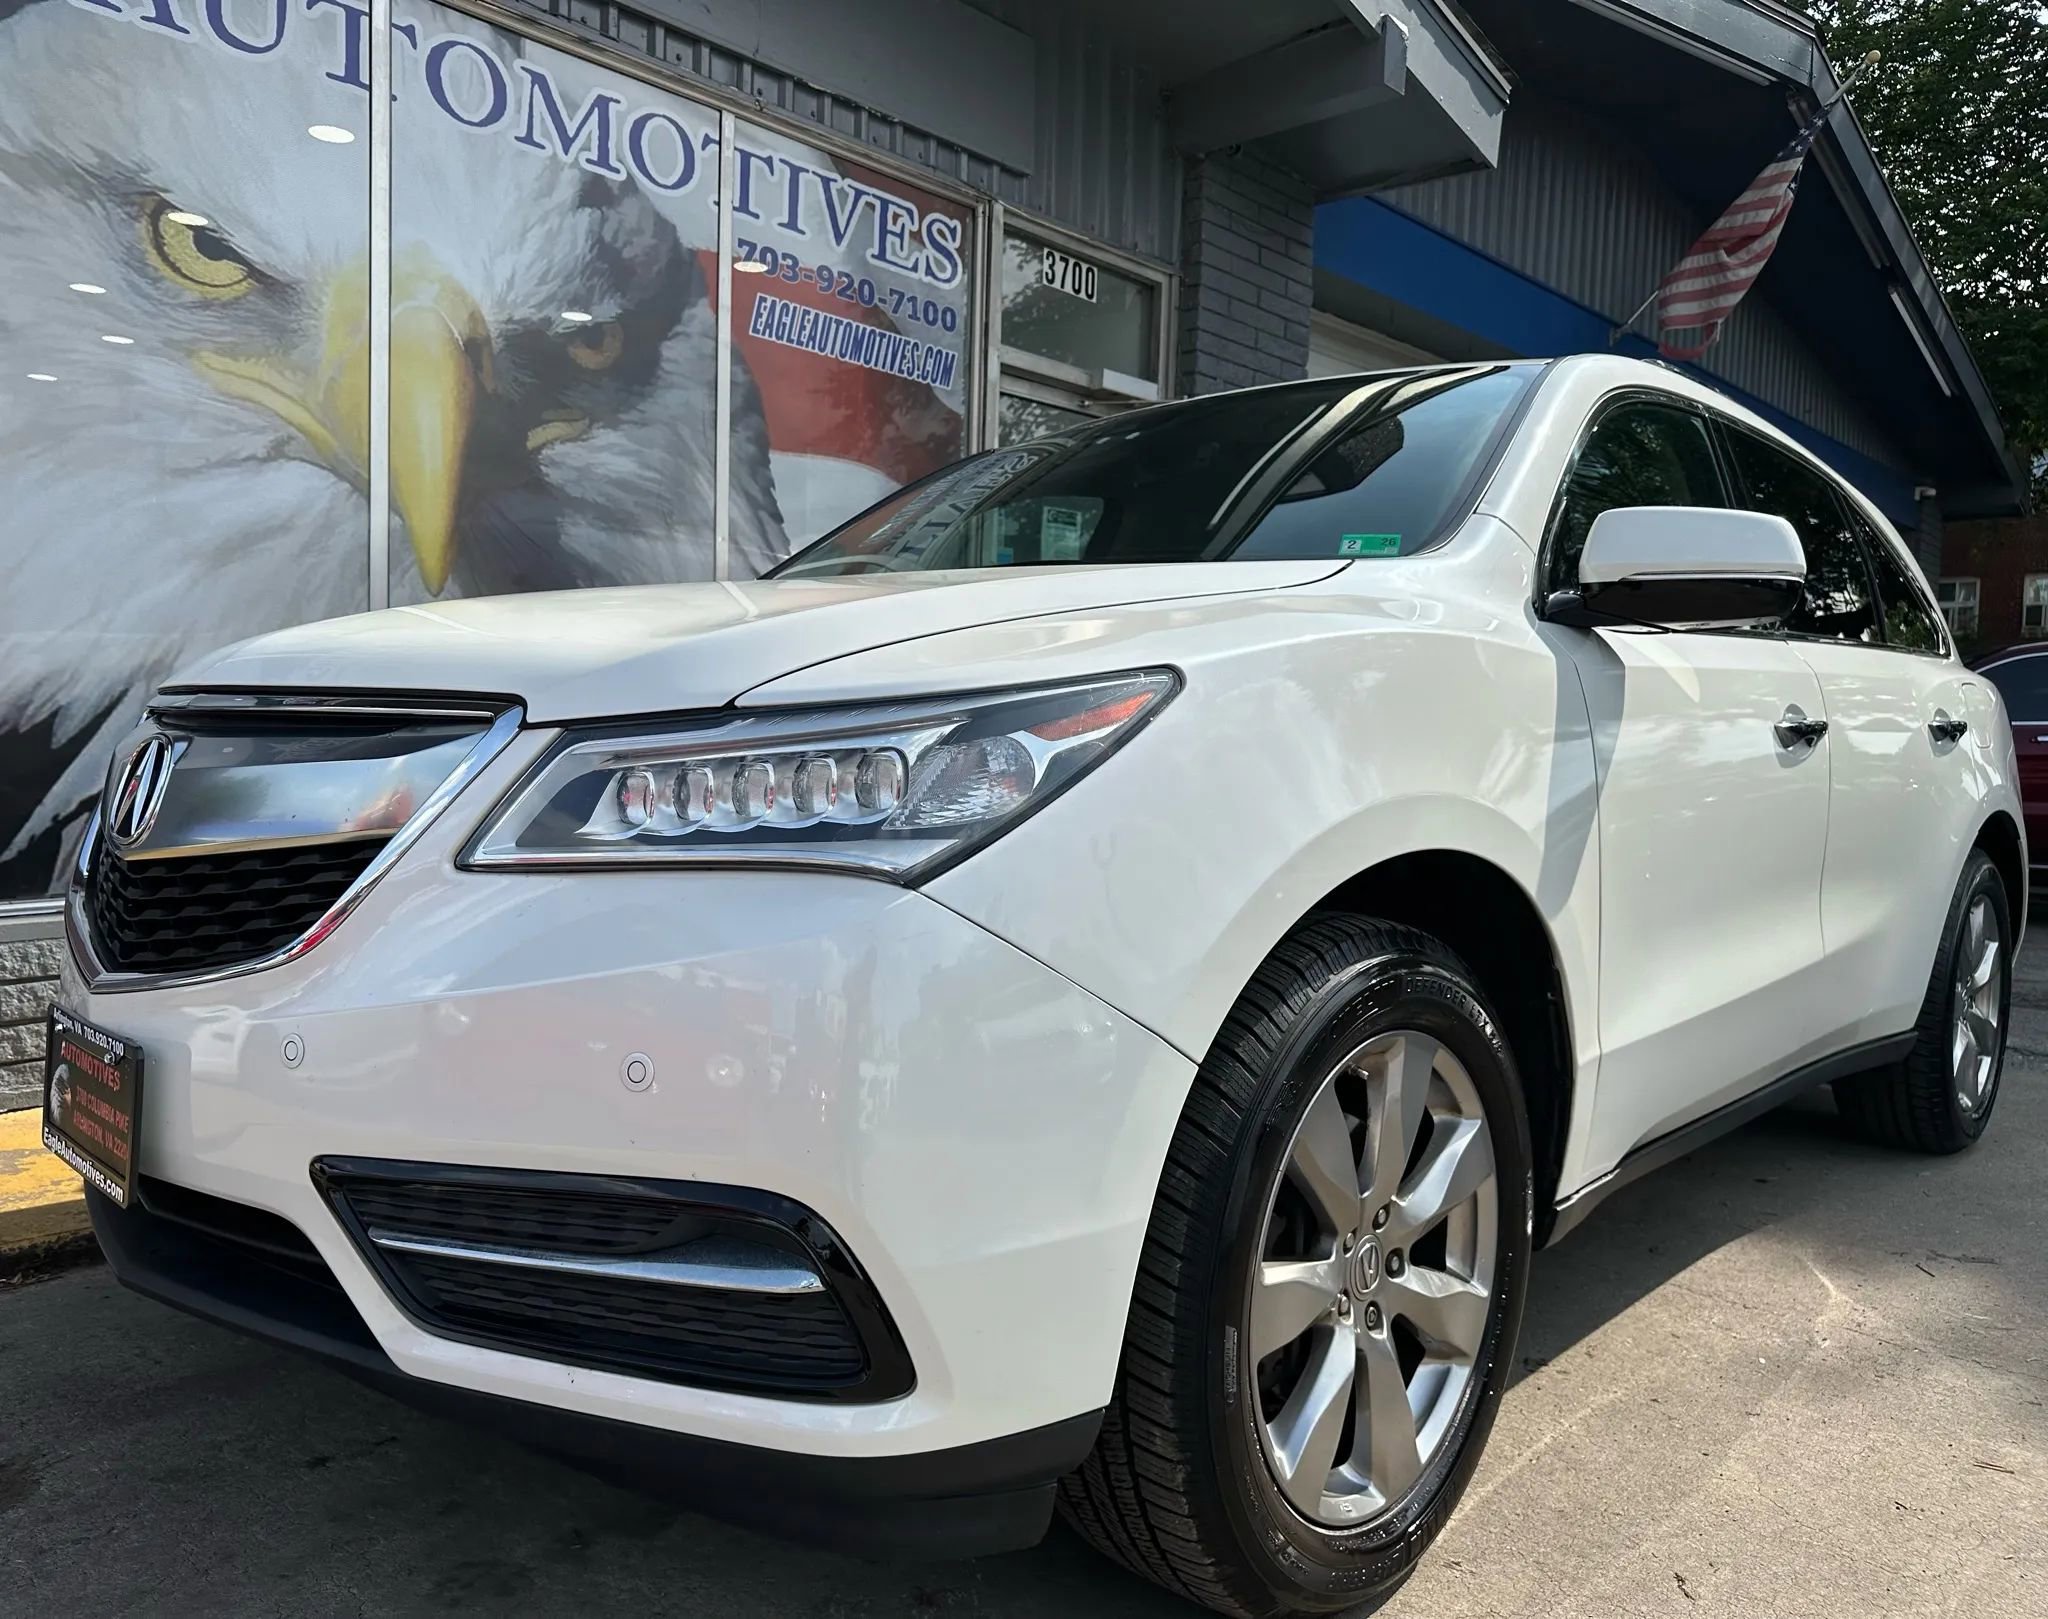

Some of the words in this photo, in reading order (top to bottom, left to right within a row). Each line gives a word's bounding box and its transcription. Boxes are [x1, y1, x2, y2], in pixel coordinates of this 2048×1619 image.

[84, 0, 960, 284] UTOMOTIVES
[736, 237, 958, 333] 703-920-7100
[1044, 250, 1096, 300] 3700
[750, 294, 958, 388] EAGLEAUTOMOTIVES.COM
[1347, 539, 1358, 550] 2
[61, 1040, 121, 1092] AUTOMOTIVES
[74, 1020, 83, 1036] VA
[84, 1025, 124, 1057] 703.920.7100
[43, 1126, 124, 1203] EagleAutomotives.com
